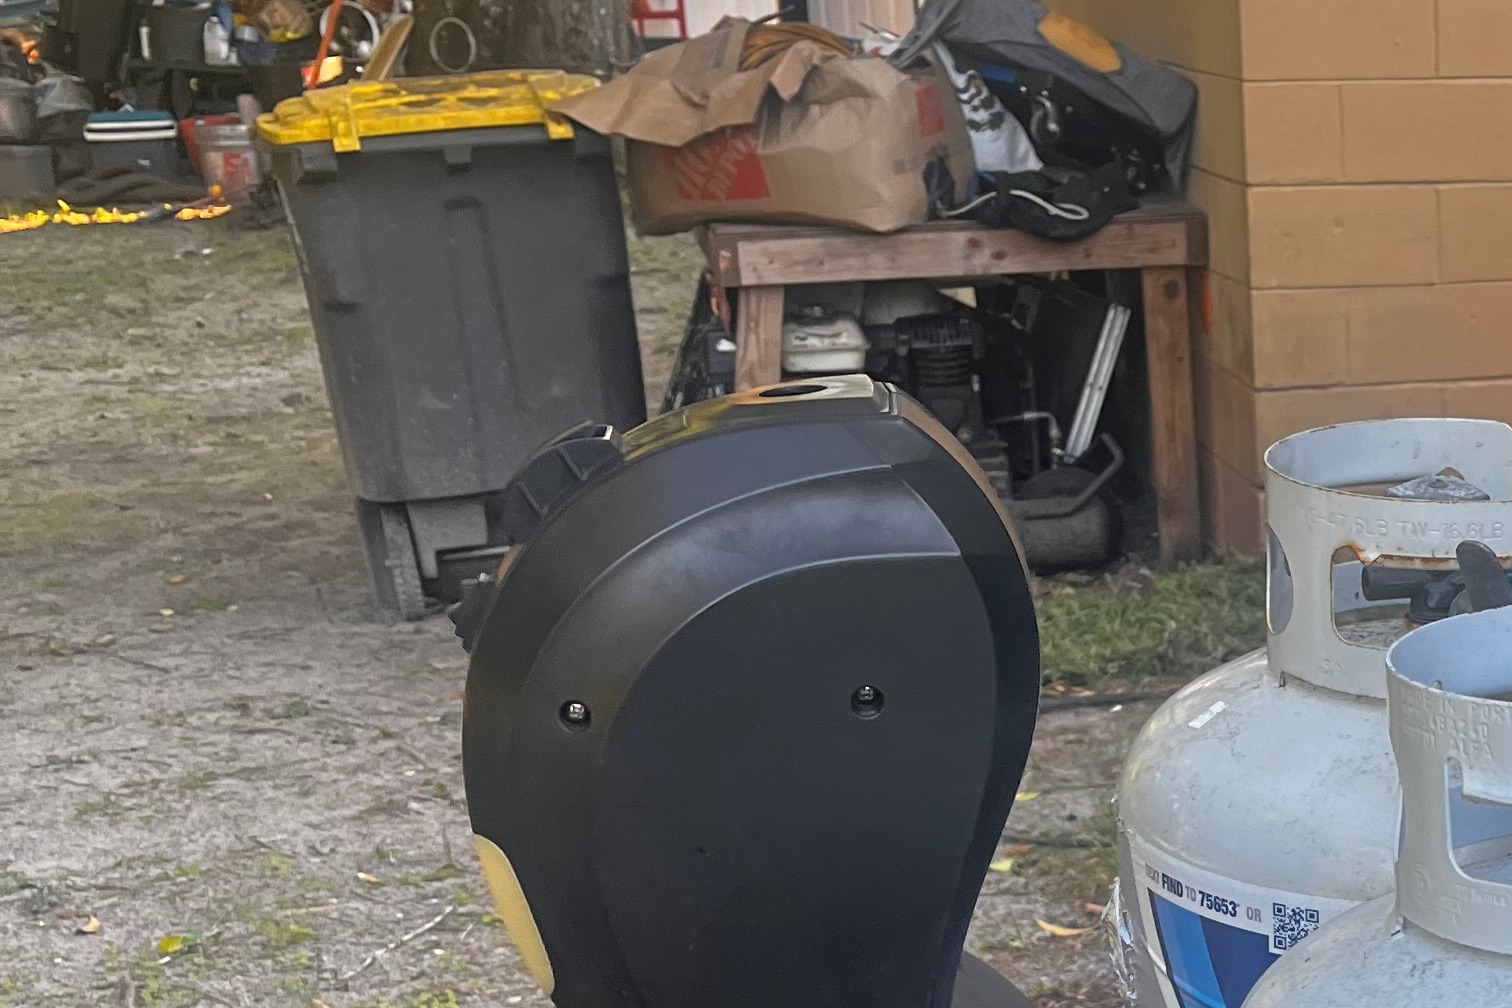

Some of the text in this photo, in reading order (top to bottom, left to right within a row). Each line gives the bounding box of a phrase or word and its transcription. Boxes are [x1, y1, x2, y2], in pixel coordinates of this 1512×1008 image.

[1161, 872, 1184, 898] FIND
[1185, 885, 1197, 902] TO
[1246, 905, 1262, 923] OR
